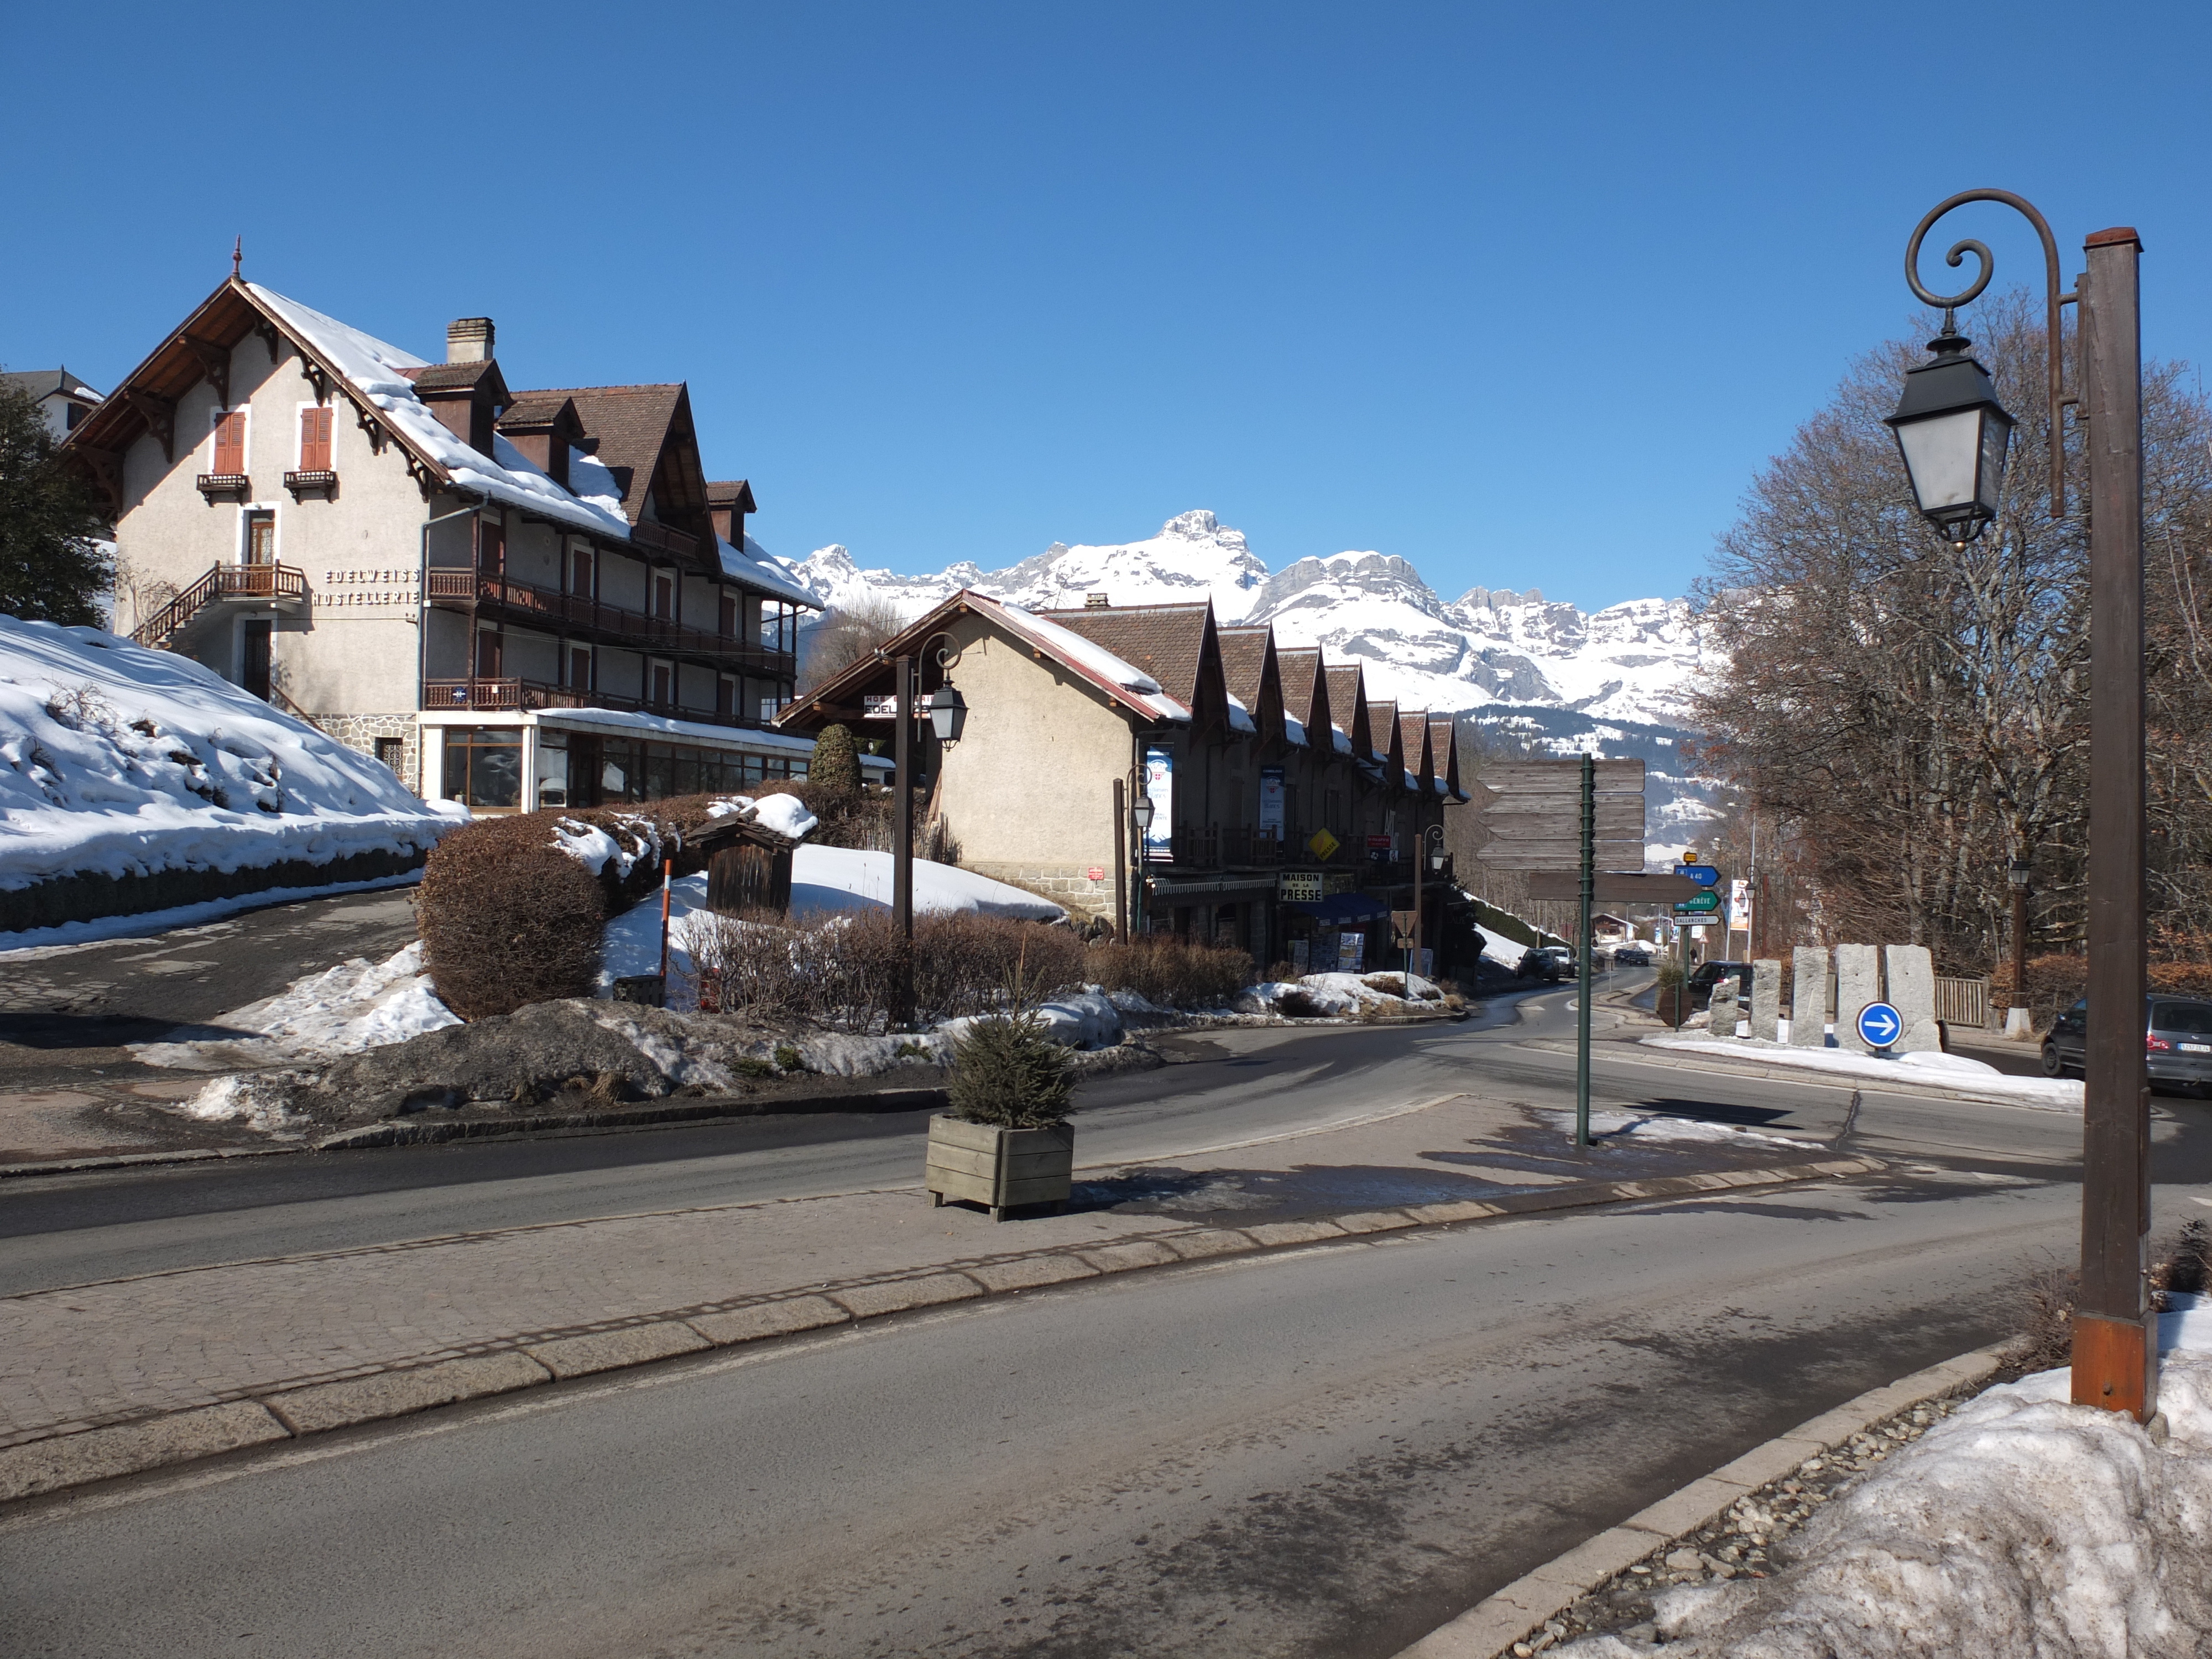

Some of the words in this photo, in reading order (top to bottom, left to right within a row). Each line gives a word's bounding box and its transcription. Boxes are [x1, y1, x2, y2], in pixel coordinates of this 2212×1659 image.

[325, 570, 420, 583] EDELWEISS
[312, 591, 420, 606] HOSTELLERIE
[1319, 842, 1336, 859] PRESSE
[1281, 889, 1321, 900] PRESSE
